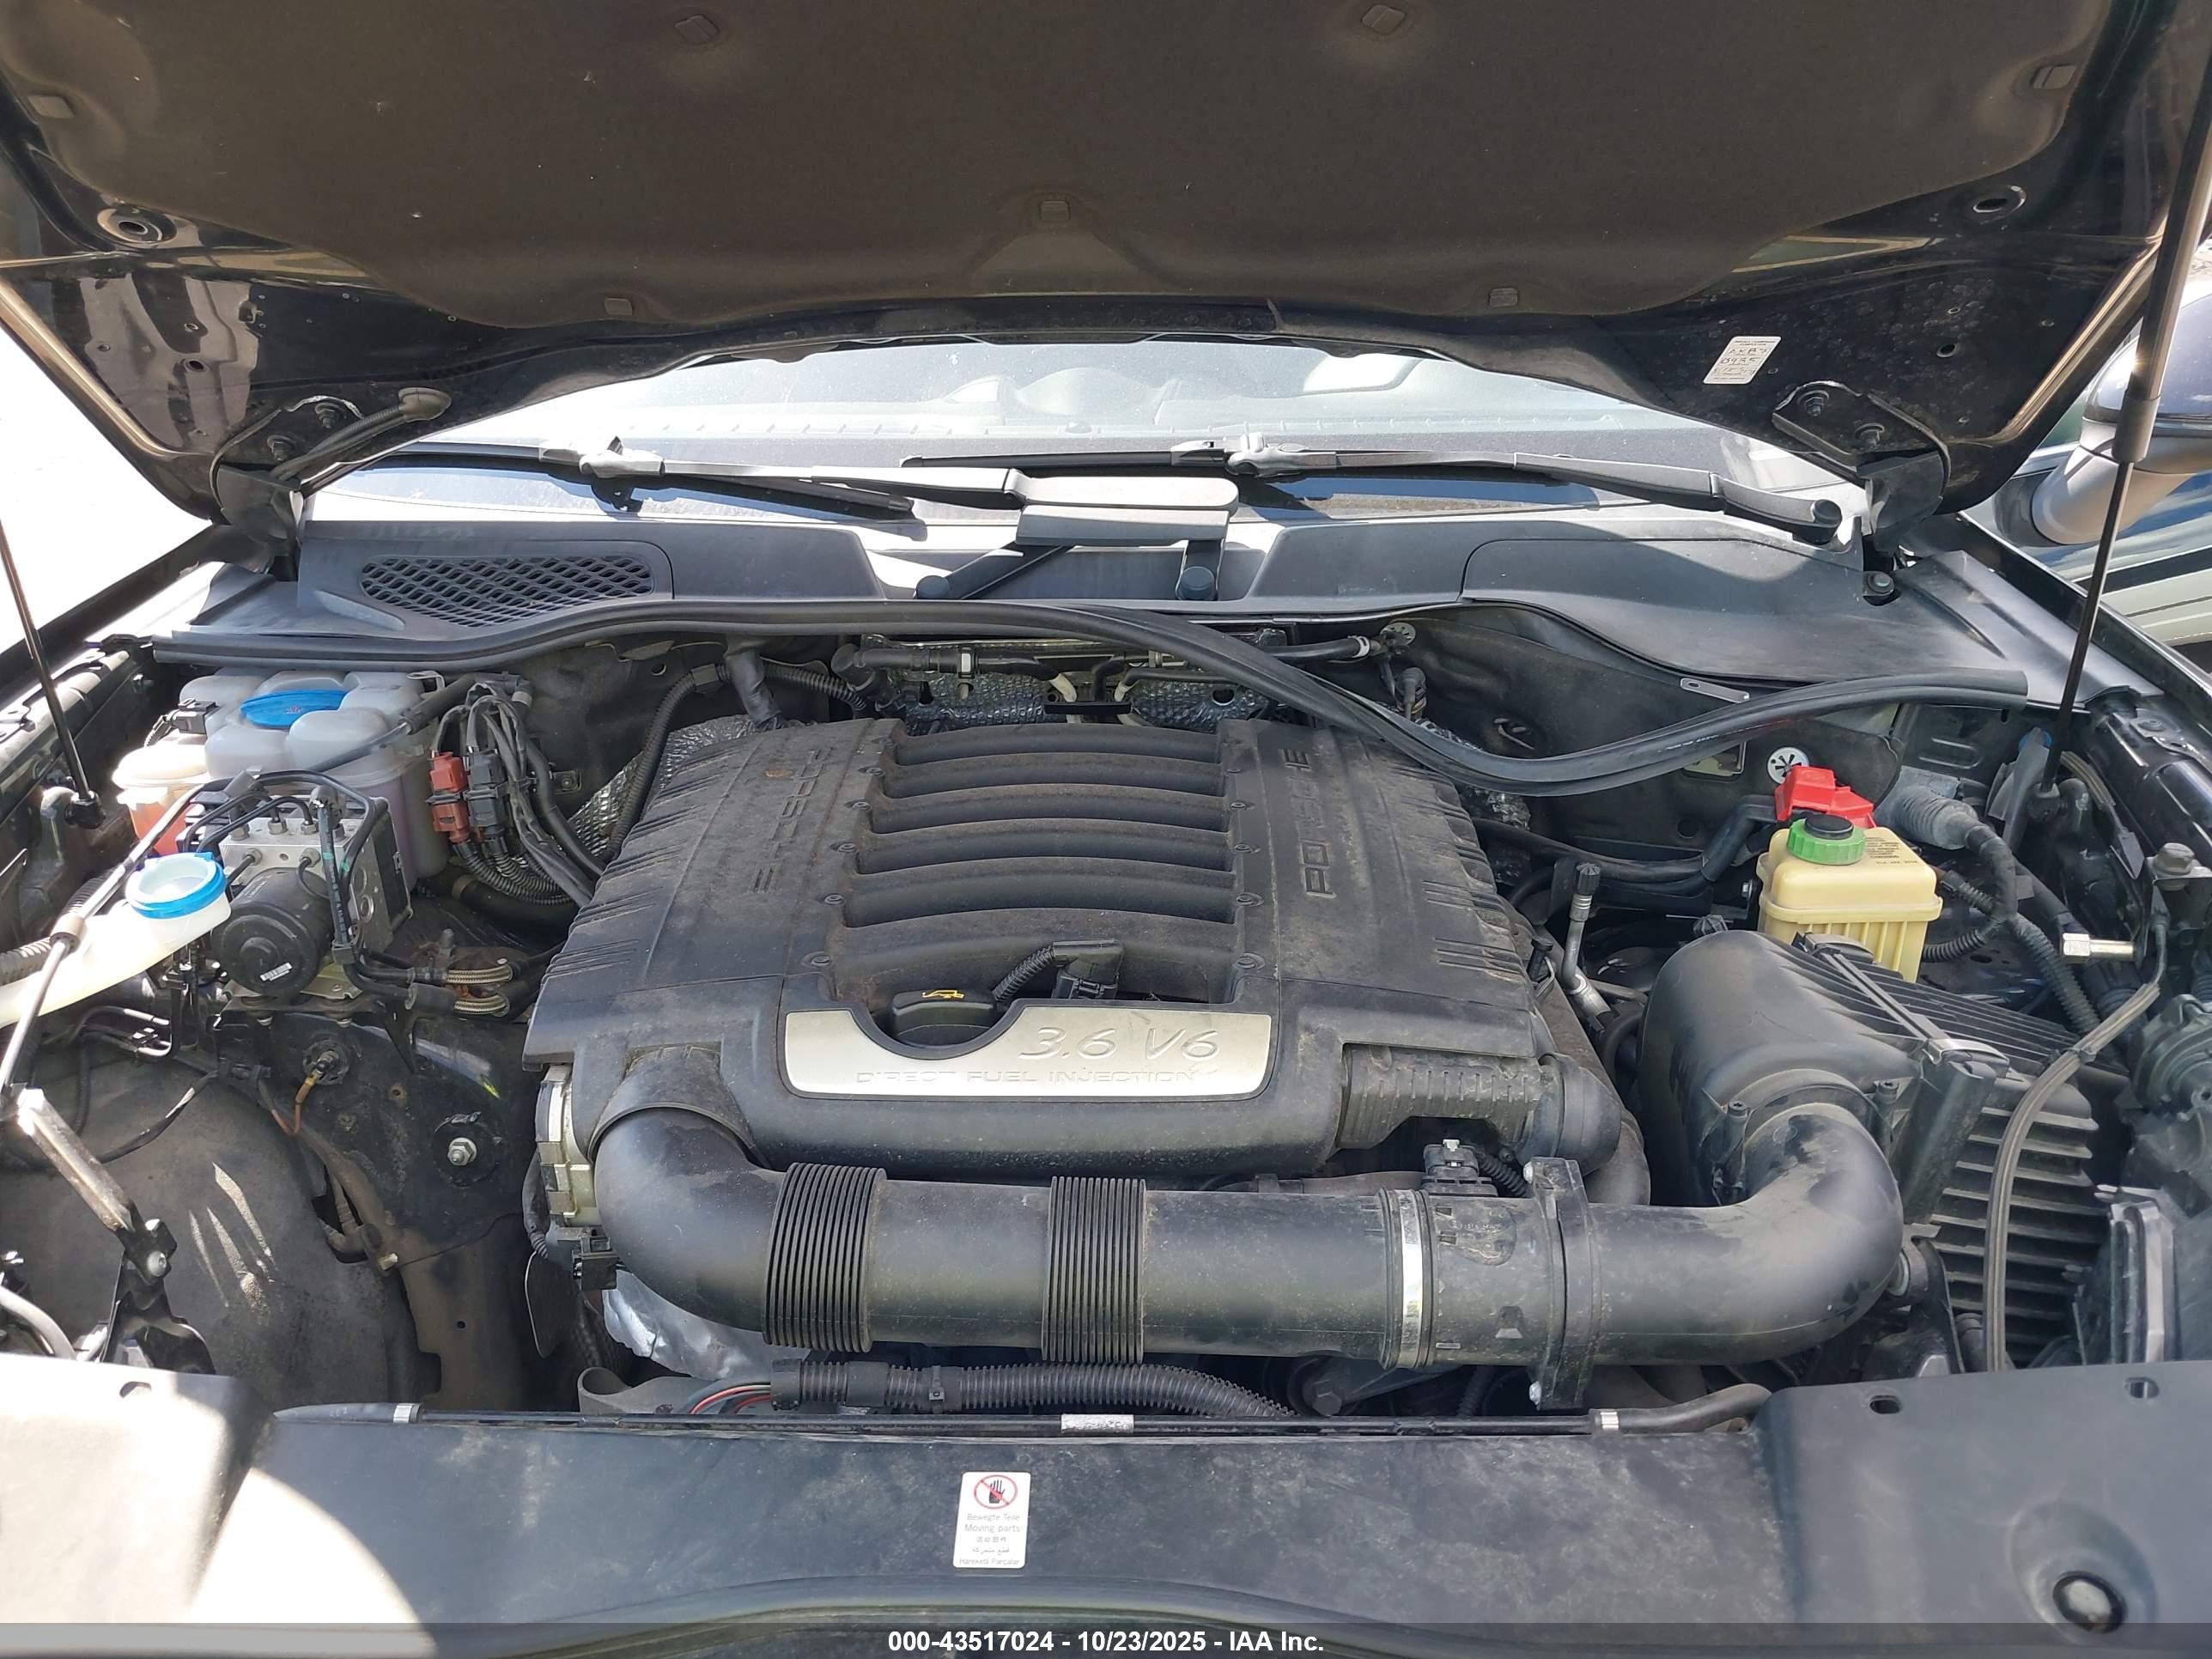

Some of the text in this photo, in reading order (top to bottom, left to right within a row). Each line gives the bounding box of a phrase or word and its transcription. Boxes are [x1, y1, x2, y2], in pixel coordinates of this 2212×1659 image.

[1018, 1026, 1220, 1061] 3.6 V6
[967, 1070, 1038, 1083] FUEL
[1048, 1070, 1196, 1083] INJECTION
[964, 1524, 995, 1534] Moving
